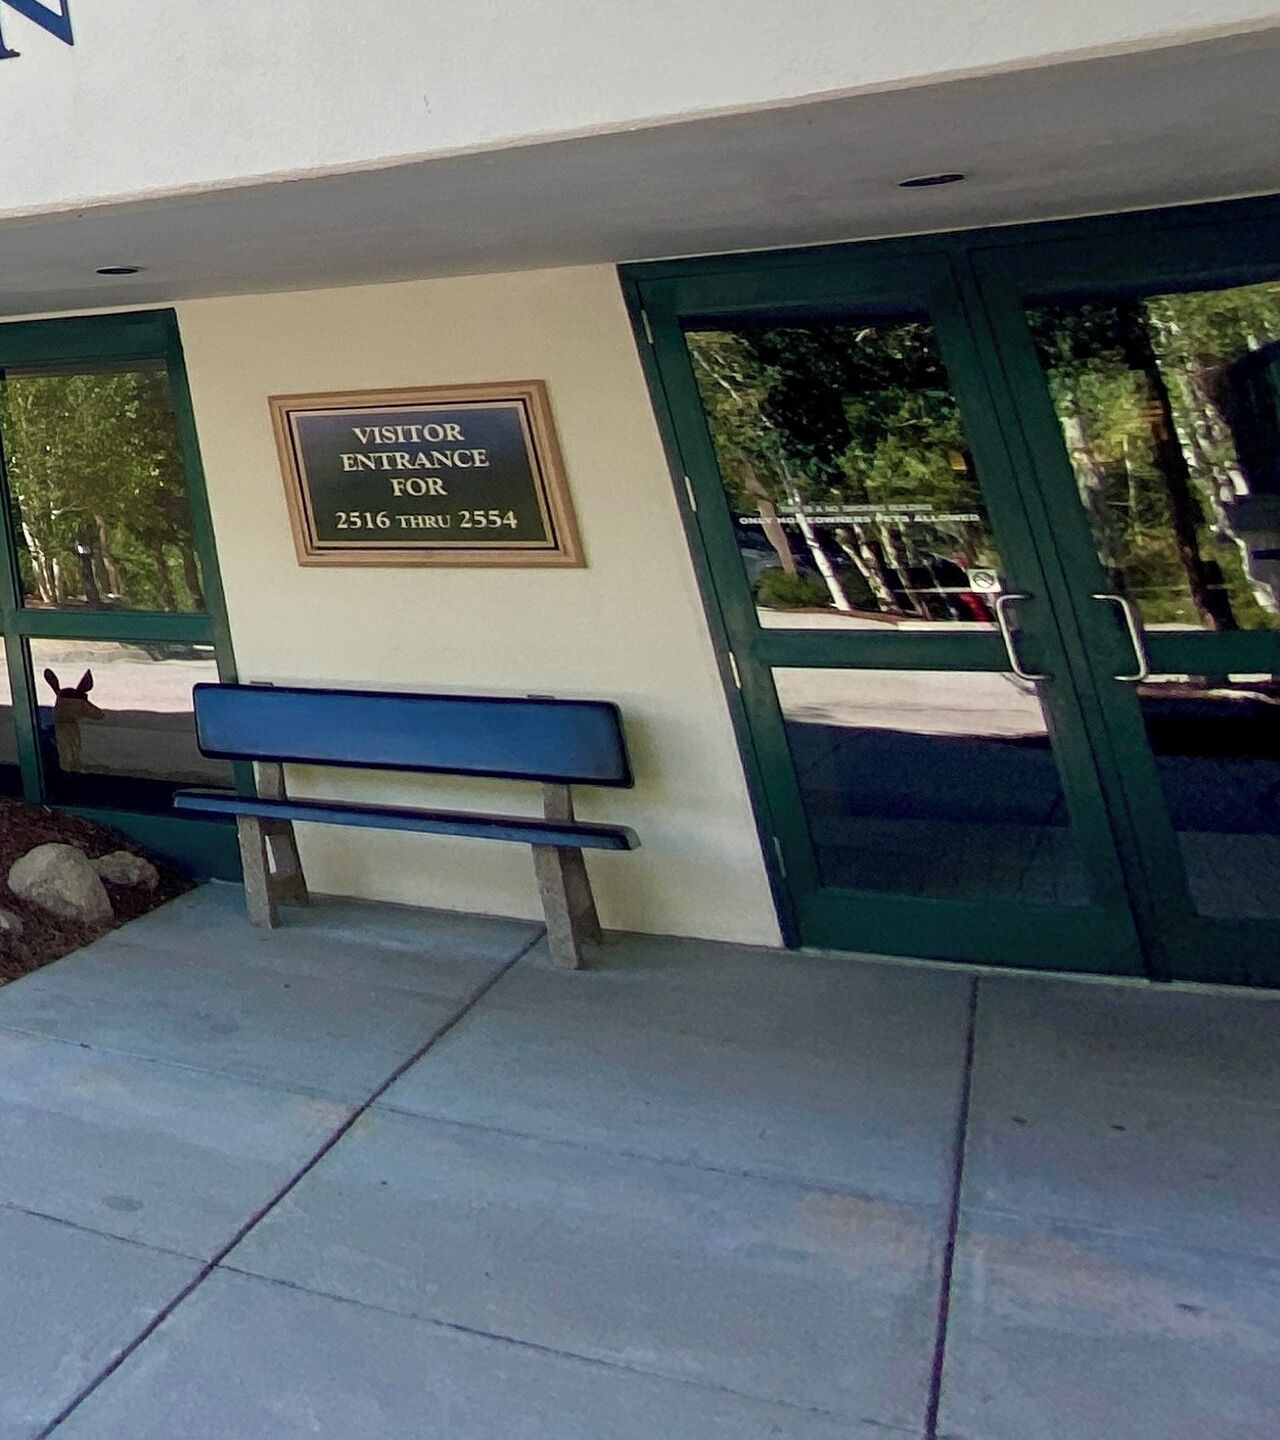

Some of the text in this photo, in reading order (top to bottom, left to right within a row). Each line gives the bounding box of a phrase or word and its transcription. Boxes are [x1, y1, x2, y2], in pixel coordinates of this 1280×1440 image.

[351, 422, 465, 445] VISITOR
[340, 449, 490, 473] ENTRANCE
[390, 477, 448, 497] FOR
[335, 510, 518, 530] 2516 THRU 2554
[914, 513, 980, 522] ALLOWED
